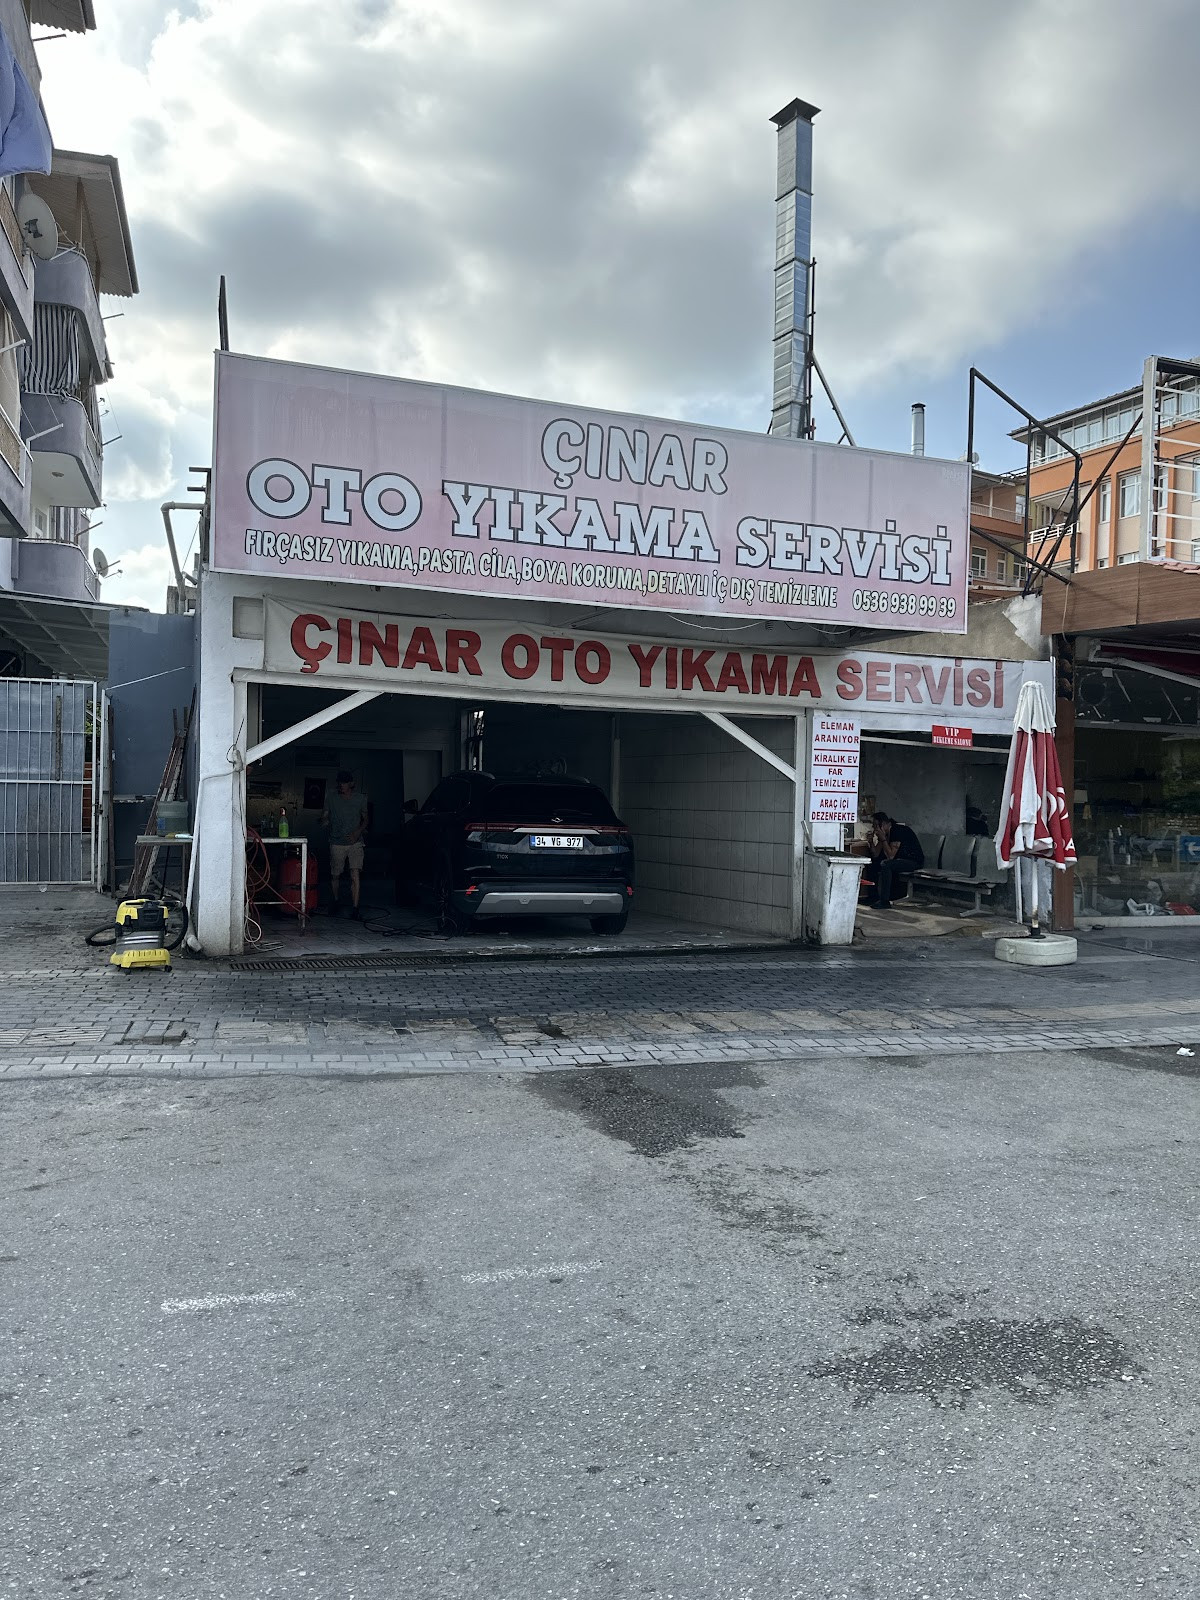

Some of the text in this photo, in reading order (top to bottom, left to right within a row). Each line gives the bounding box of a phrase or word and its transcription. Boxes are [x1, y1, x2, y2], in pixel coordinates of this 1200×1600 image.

[541, 417, 728, 495] ÇINAR
[246, 457, 952, 586] OTO YIKAMA SERVİSİ
[245, 529, 335, 565] FIRÇASIZ
[711, 569, 728, 604] İÇ
[730, 577, 755, 606] DIŞ
[757, 577, 837, 608] TEMİZLEME
[852, 589, 957, 619] 0536 938 99 39
[290, 613, 1005, 709] ÇINAR OTO YIKAMA SERVİSİ
[820, 721, 854, 731] ELEMAN
[945, 727, 960, 737] VIP
[814, 733, 860, 744] ARANIYOR
[814, 752, 858, 764] KİRALIK EV
[828, 767, 843, 776] FAR
[814, 777, 856, 788] TEMİZLEME
[819, 798, 838, 809] ARAÇ
[811, 811, 855, 821] DEZENFEKTE
[536, 836, 581, 847] 34 VG 977
